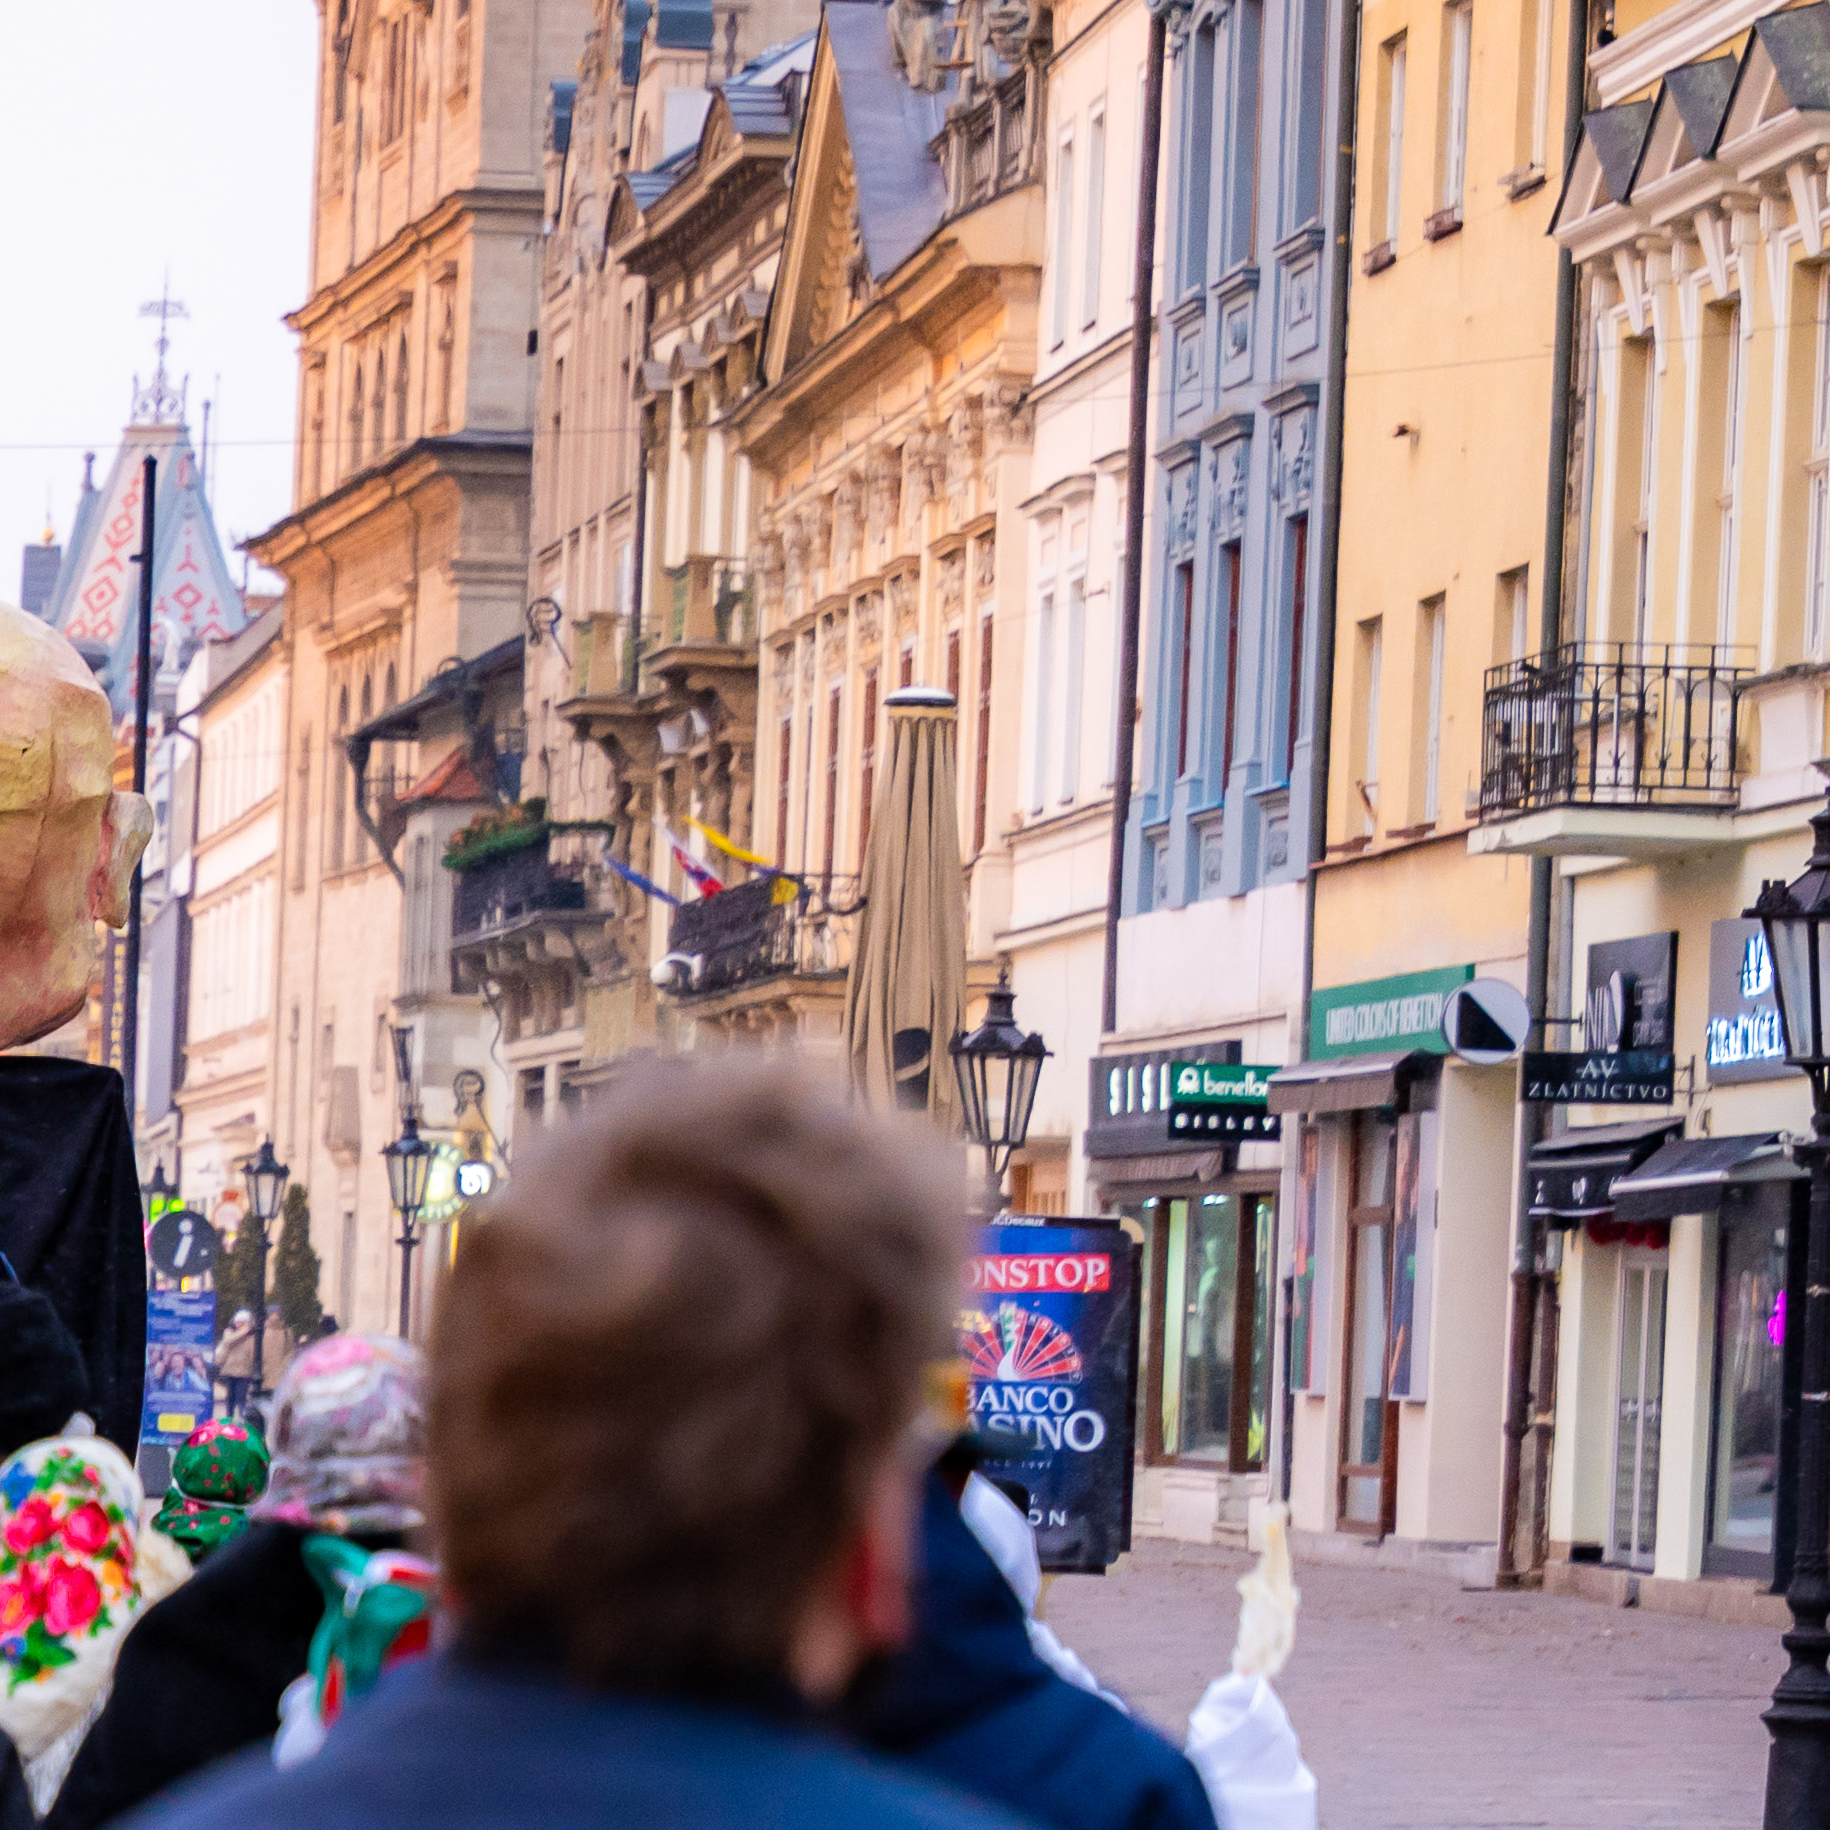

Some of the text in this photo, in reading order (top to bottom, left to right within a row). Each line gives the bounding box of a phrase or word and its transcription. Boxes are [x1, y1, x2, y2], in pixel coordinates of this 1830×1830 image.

[1108, 1062, 1172, 1116] SISL
[1528, 1078, 1669, 1100] ZLATNÍCTVO
[961, 1257, 1107, 1290] ONSTOP
